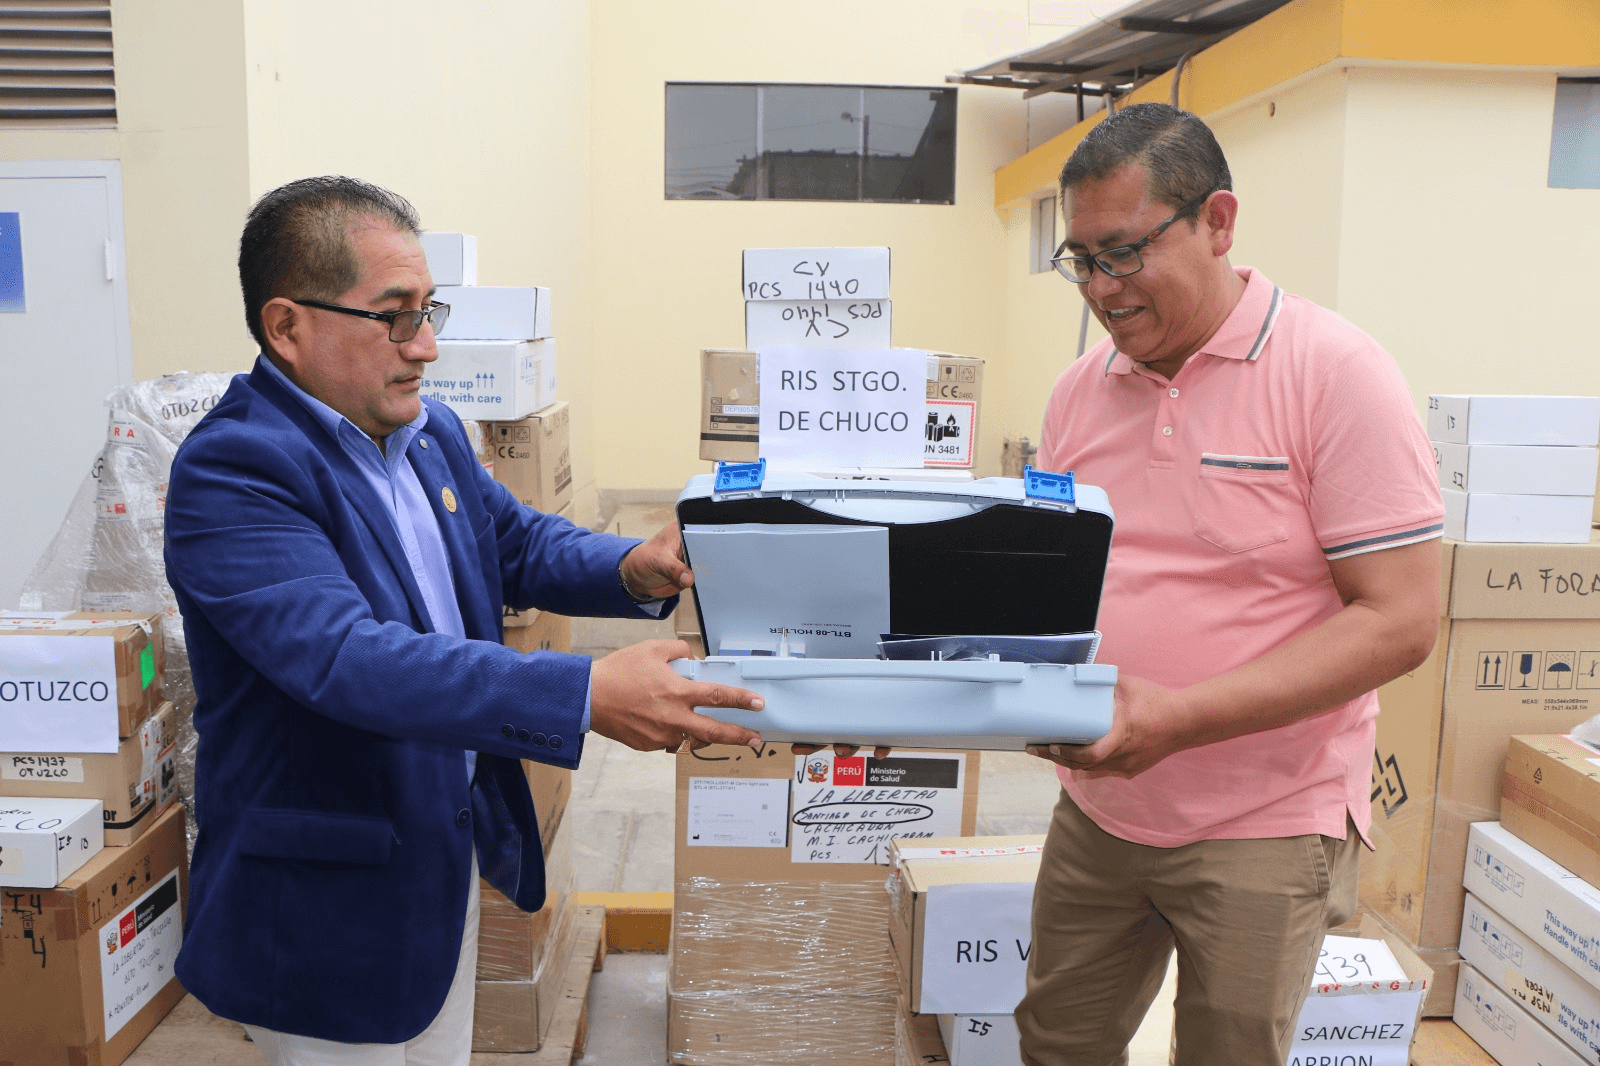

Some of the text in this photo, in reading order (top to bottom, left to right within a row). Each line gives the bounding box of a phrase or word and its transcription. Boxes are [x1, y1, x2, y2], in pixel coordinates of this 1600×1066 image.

[748, 278, 859, 299] PCS 1440
[782, 302, 882, 321] PCS 1440
[433, 379, 456, 389] way
[459, 379, 474, 389] up
[781, 370, 907, 392] RIS STGO.
[449, 392, 475, 403] with
[477, 394, 502, 404] care
[779, 411, 909, 432] DE CHUCO
[938, 445, 960, 455] 3481
[1487, 568, 1522, 591] LA
[0, 681, 109, 702] OTUZCO
[38, 756, 66, 767] 1437
[836, 765, 862, 776] PERÚ
[870, 767, 906, 775] Ministerio
[19, 768, 69, 778] OTUZCO
[808, 788, 938, 804] LA LIBERTAD
[860, 810, 878, 819] DE
[886, 807, 921, 817] CHUCO
[1546, 909, 1589, 949] This way up
[956, 939, 999, 964] RIS
[1543, 922, 1569, 949] Handle
[1570, 944, 1588, 963] with
[1560, 1002, 1577, 1021] way
[1578, 1016, 1589, 1030] up
[1301, 1023, 1405, 1041] SANCHEZ
[1570, 1023, 1588, 1044] with
